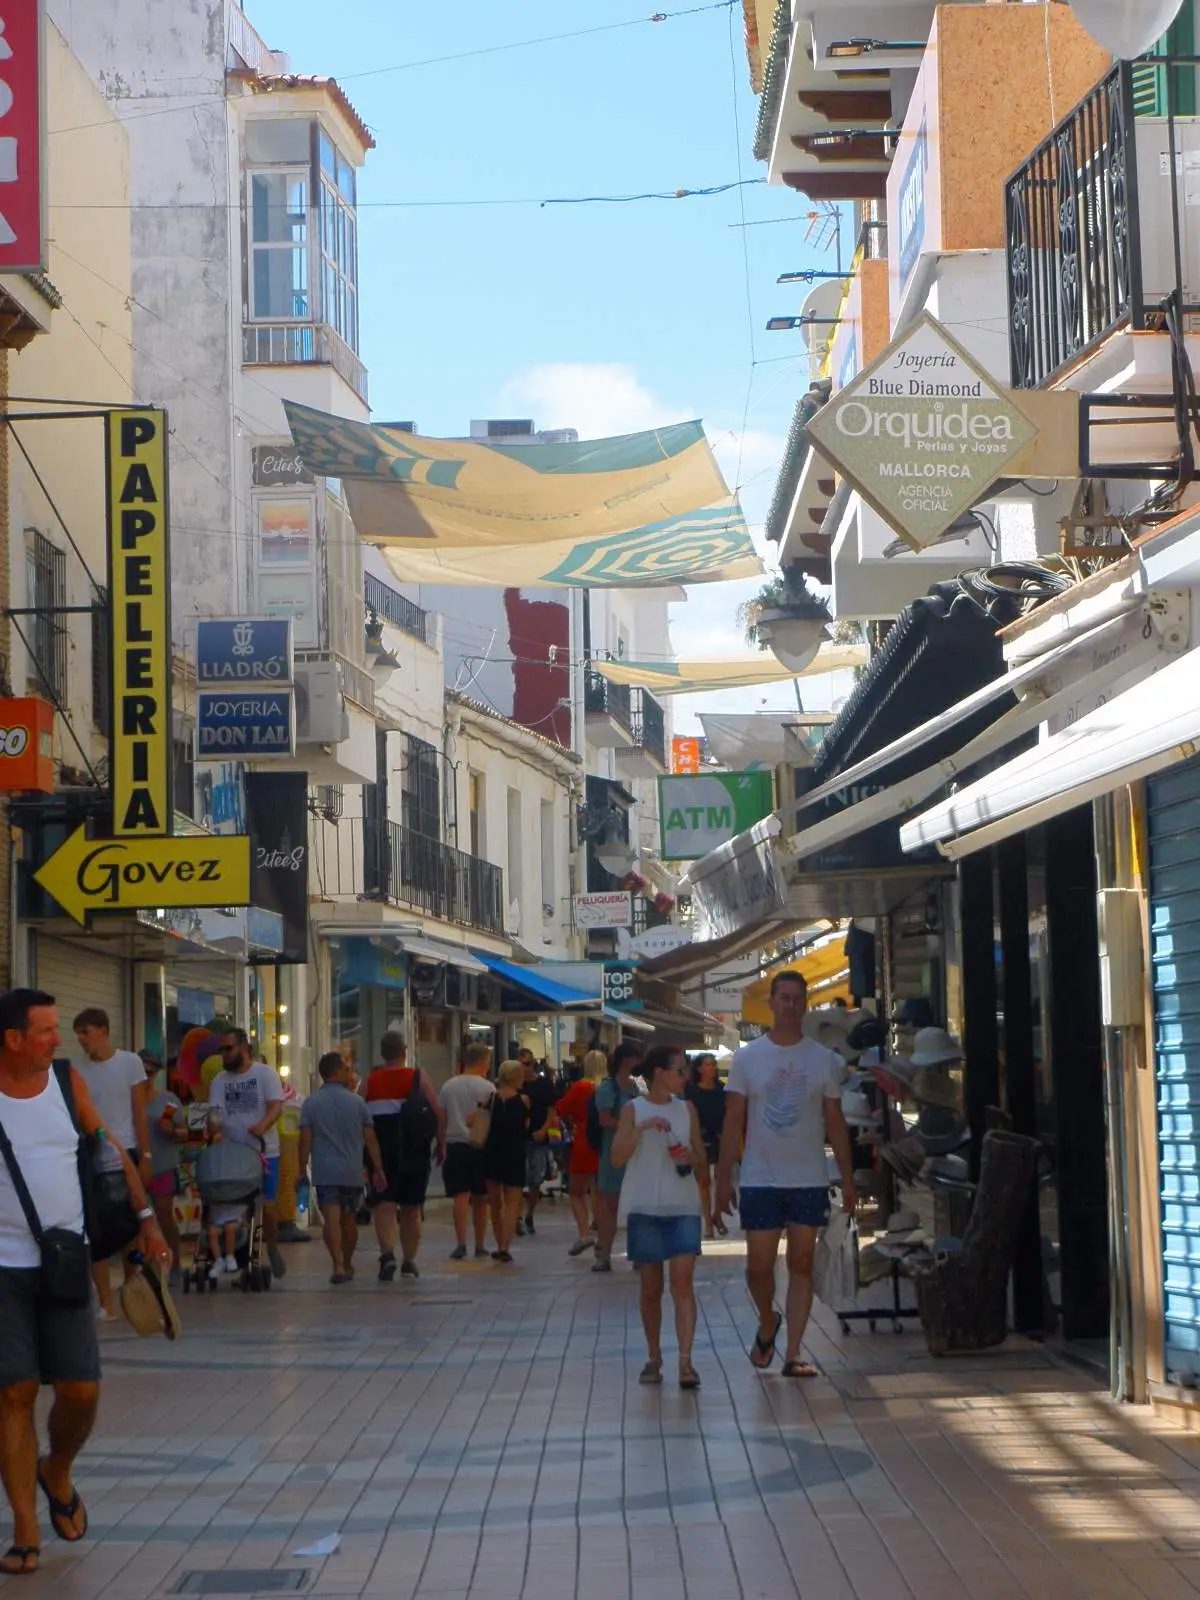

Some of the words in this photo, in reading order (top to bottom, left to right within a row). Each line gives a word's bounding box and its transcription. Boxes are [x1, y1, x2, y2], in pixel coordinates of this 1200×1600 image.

[894, 351, 957, 373] Joyería
[869, 378, 904, 396] Blue
[908, 379, 981, 397] Diamond
[835, 401, 1015, 449] Orquidea
[917, 440, 954, 452] Perlas
[959, 442, 968, 454] y
[971, 441, 1008, 455] Joyas
[879, 462, 972, 478] MALLORCA
[897, 485, 953, 497] AGENCIA
[902, 499, 949, 512] OFICIAL
[118, 417, 160, 829] PAPELERIA
[202, 656, 282, 681] LLADRÓ
[206, 701, 282, 717] JOYERIA
[200, 726, 246, 745] DON
[252, 725, 289, 745] LAL
[666, 805, 732, 830] ATM
[604, 972, 633, 985] TOP
[604, 986, 633, 1000] TOP
